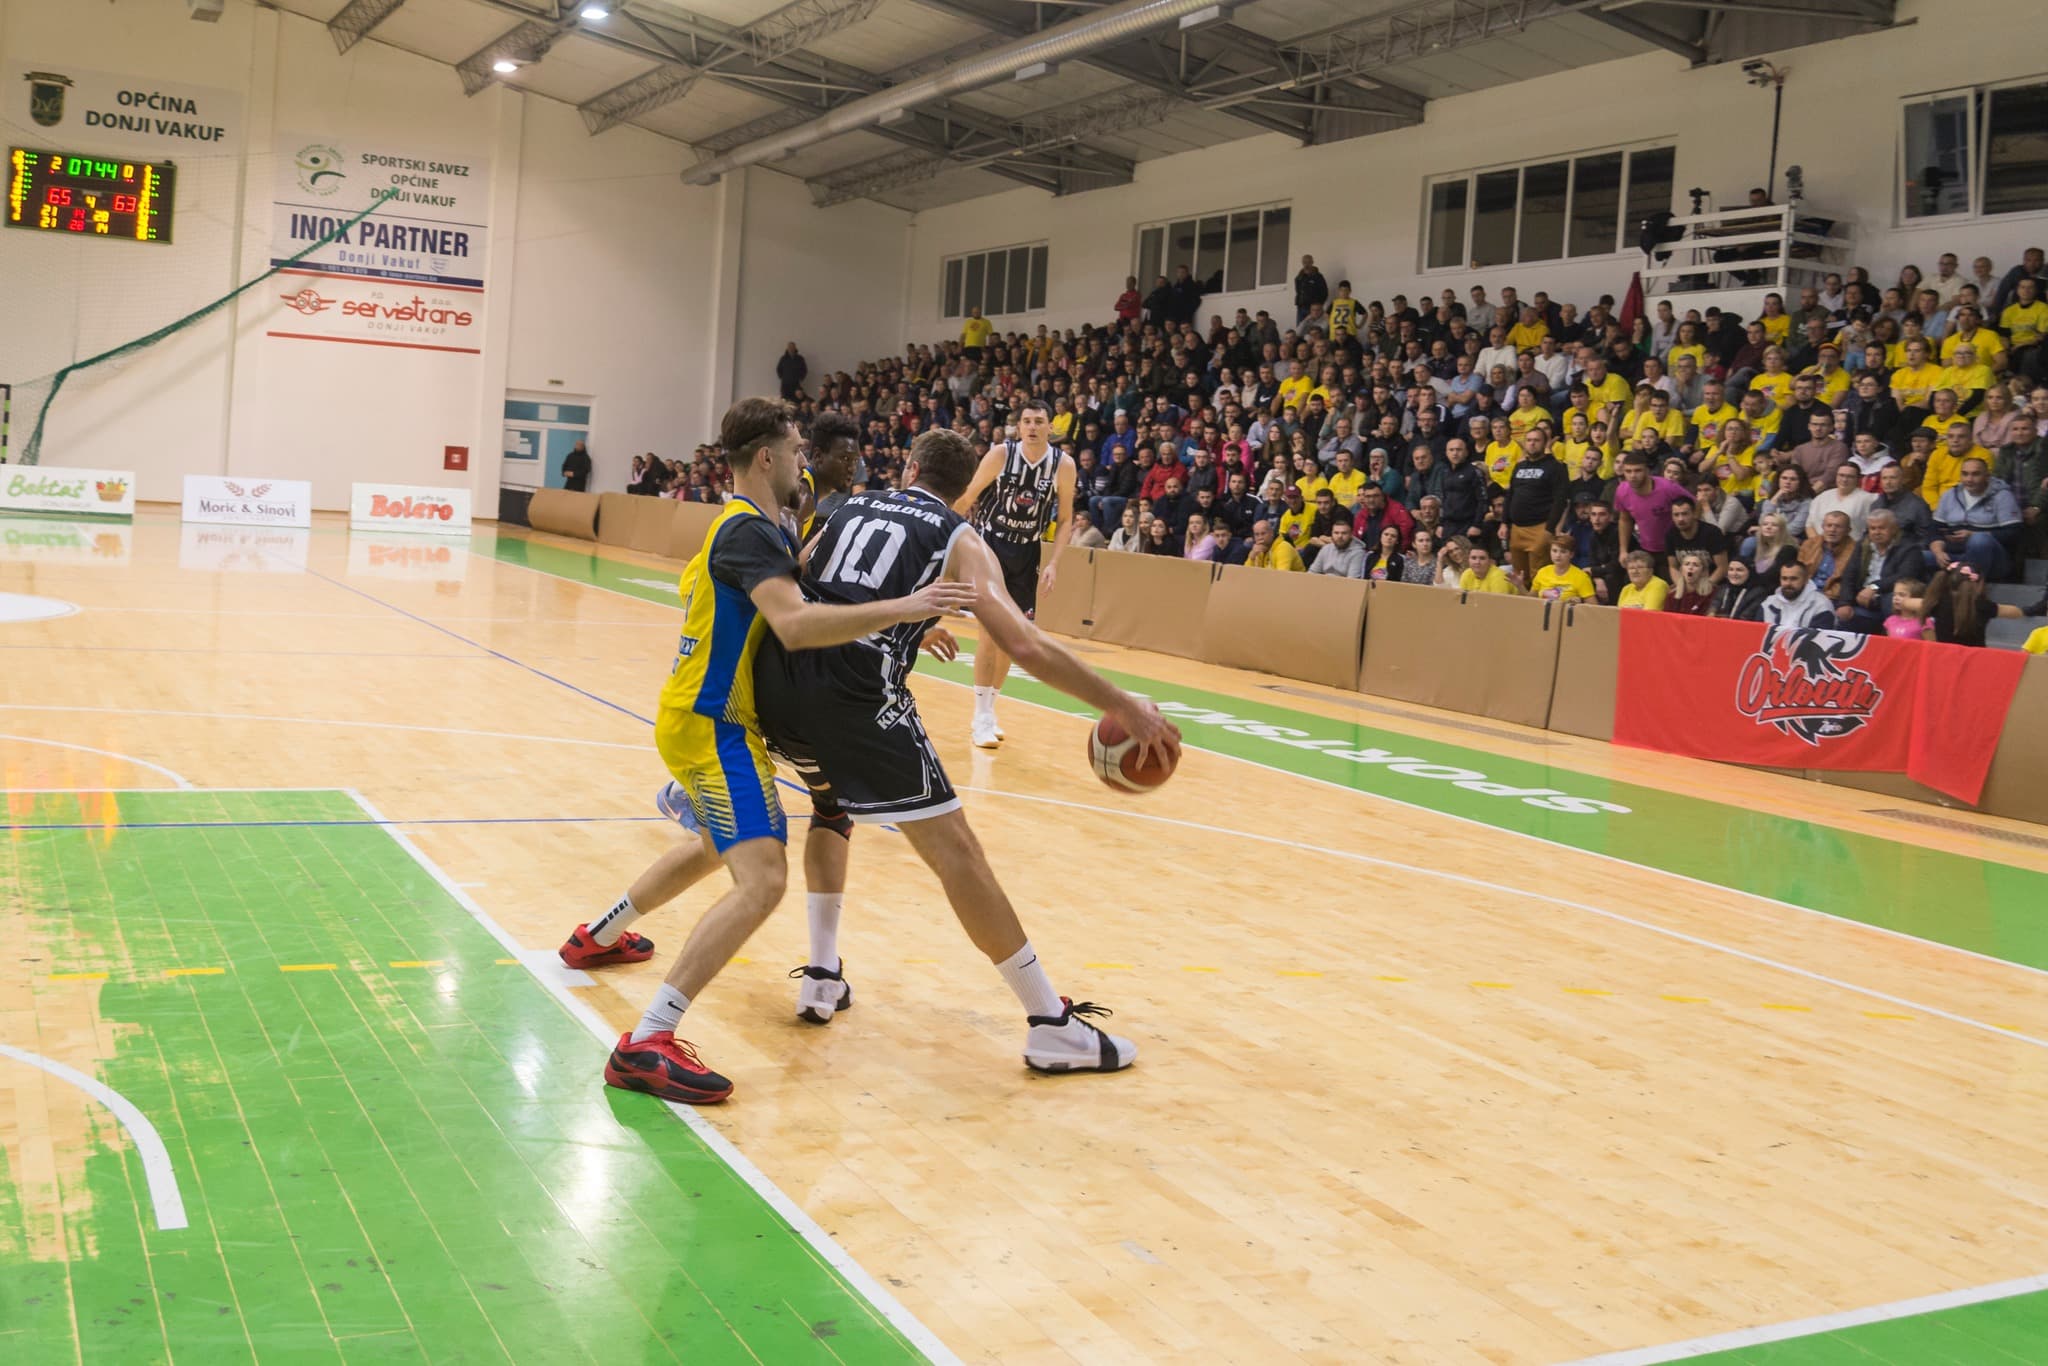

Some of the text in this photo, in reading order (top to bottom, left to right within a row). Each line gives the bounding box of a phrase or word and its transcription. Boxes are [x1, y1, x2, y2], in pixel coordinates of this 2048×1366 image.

[117, 91, 198, 115] OPČINA
[85, 110, 225, 142] DONJI VAKUF
[51, 156, 62, 170] 2
[123, 165, 134, 178] 0
[361, 153, 469, 177] SPORTSKI SAVEZ
[390, 173, 439, 189] OPĆINE
[48, 187, 71, 206] 65
[86, 196, 96, 208] 4
[113, 194, 137, 212] 63
[371, 188, 456, 207] DONJI VAKUF
[290, 213, 469, 257] INOX PARTNER
[339, 250, 375, 266] Donji
[382, 254, 420, 269] Vakuf
[342, 296, 472, 326] servistrans
[241, 503, 252, 513] &
[369, 494, 454, 521] Bolero
[844, 496, 945, 528] KK ORLOVIK
[819, 516, 907, 590] 10
[876, 708, 901, 730] KK
[1155, 701, 1633, 814] SPORTSKA
